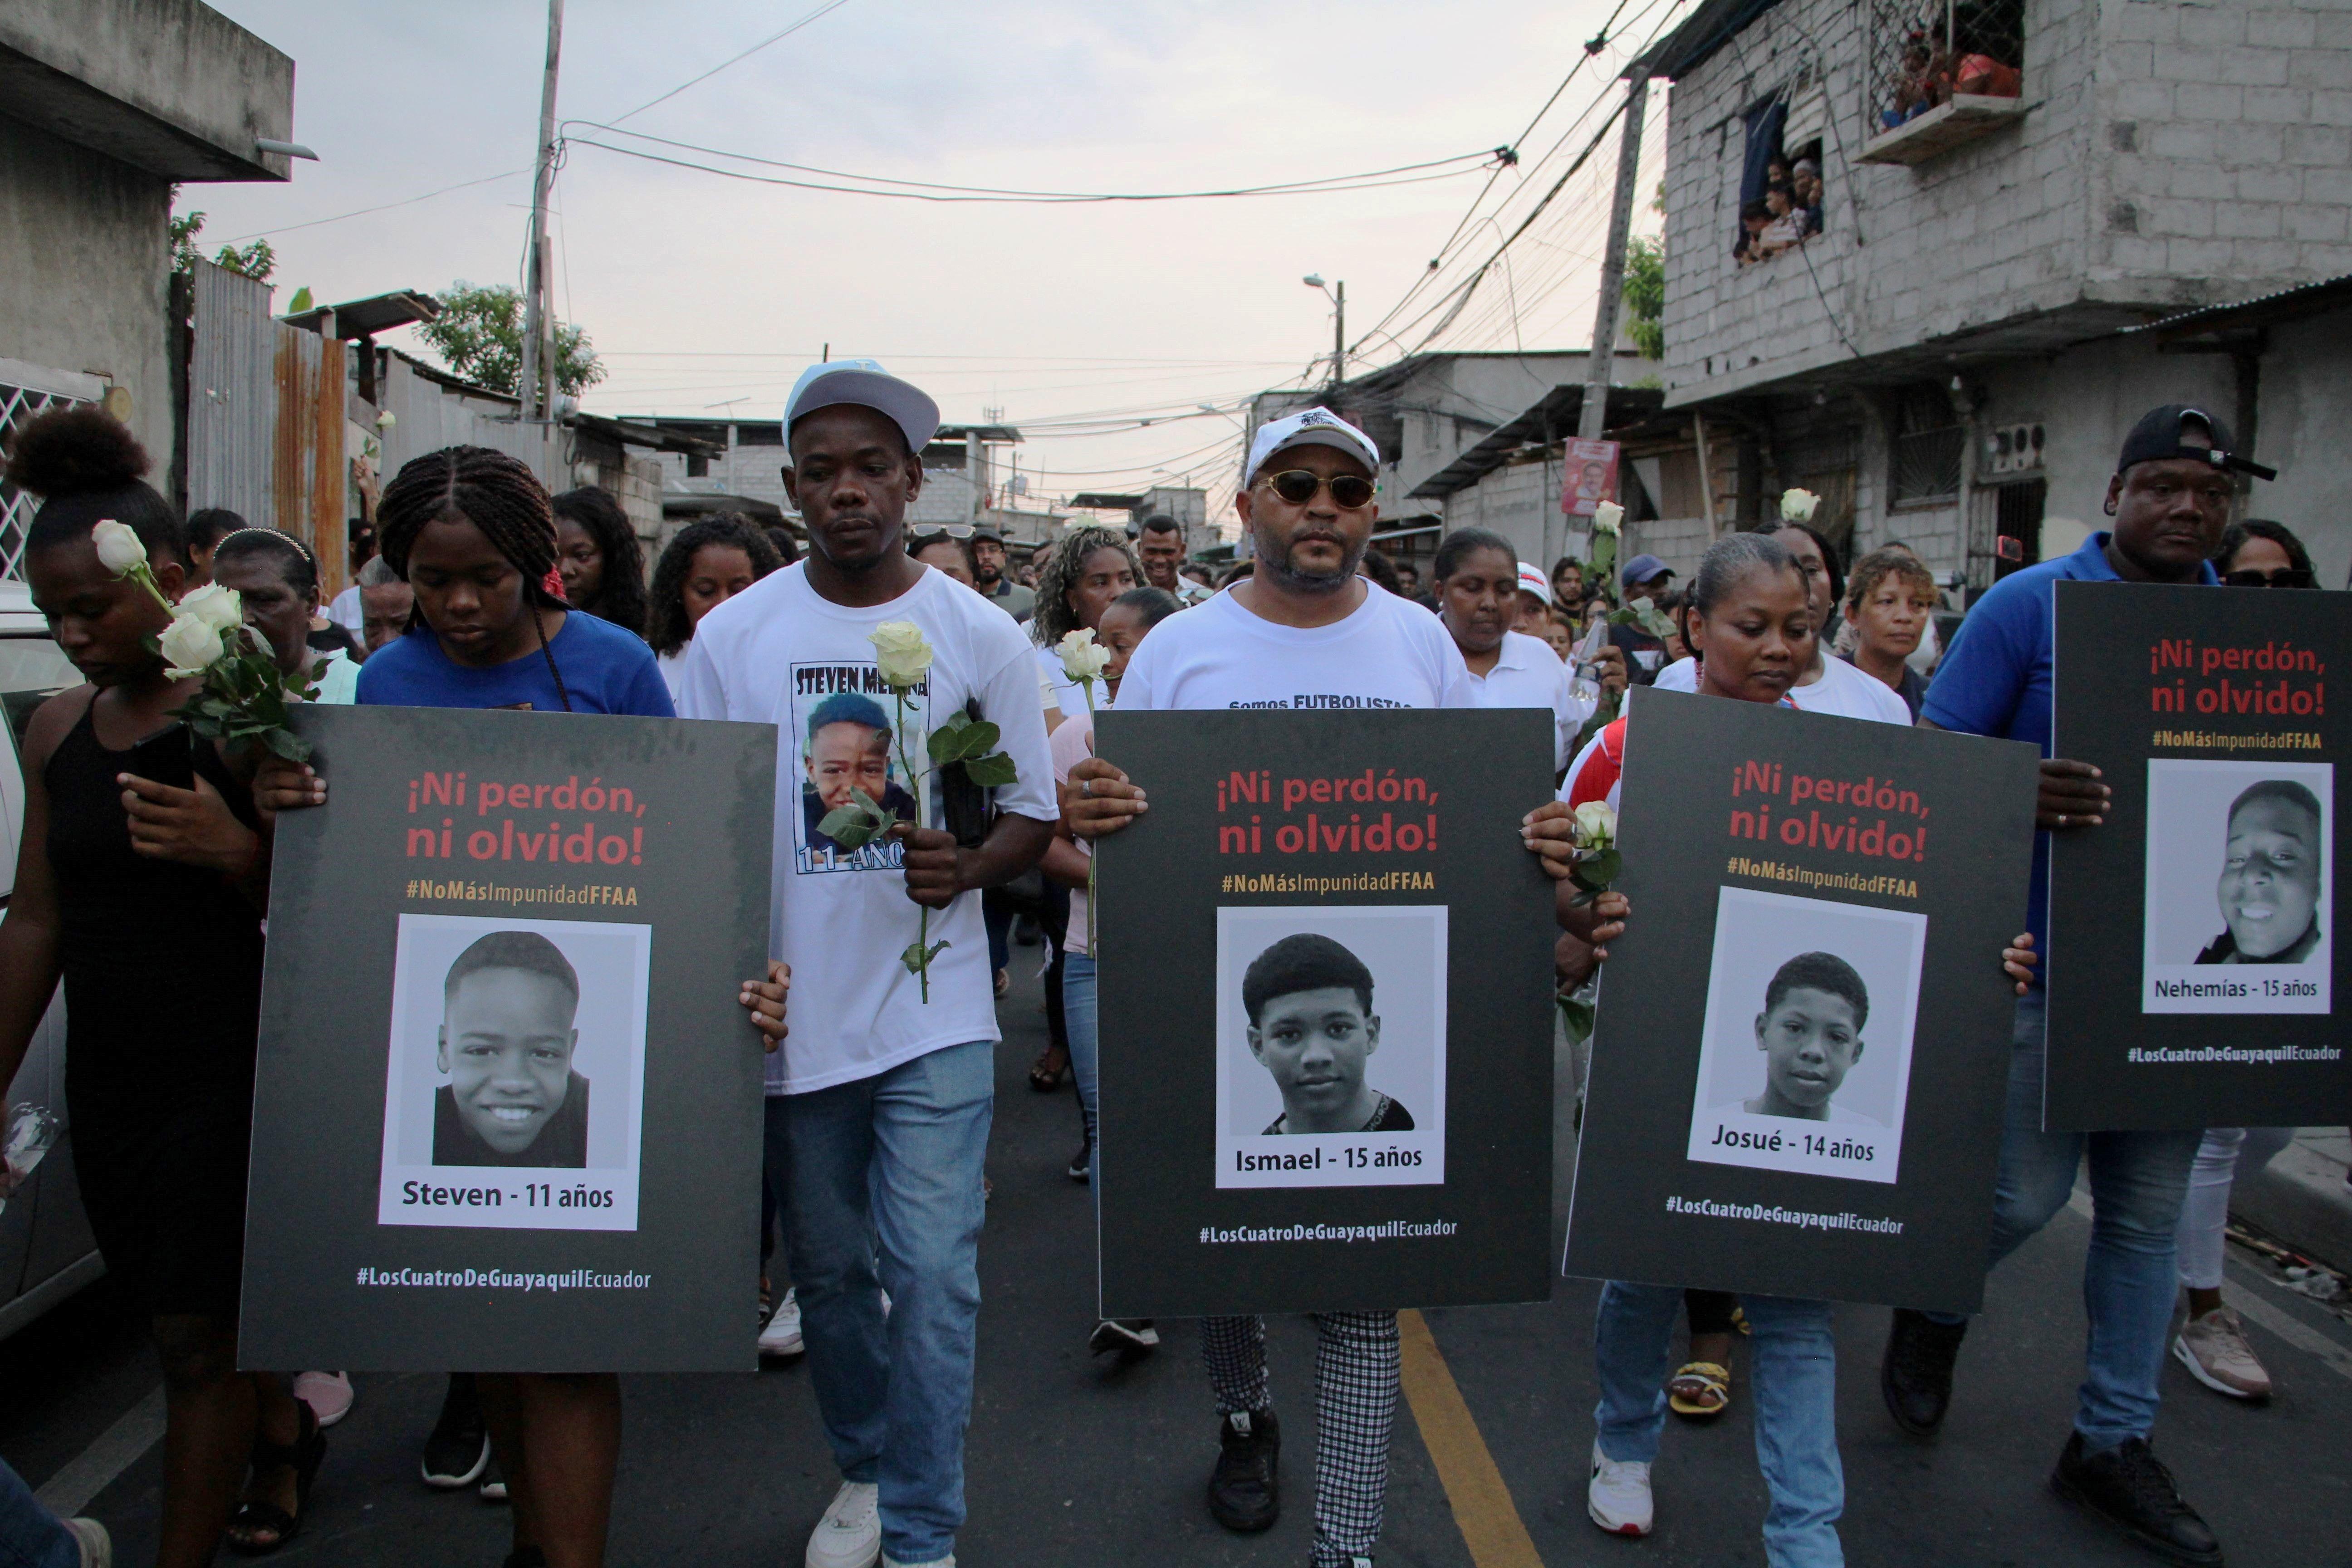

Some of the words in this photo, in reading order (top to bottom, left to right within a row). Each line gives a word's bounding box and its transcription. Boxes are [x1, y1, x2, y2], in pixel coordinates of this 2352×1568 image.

[2151, 639, 2192, 674] ¡Ni
[2202, 641, 2325, 676] perdón,
[796, 666, 859, 695] STEVEN
[2152, 678, 2185, 712] ni
[2196, 679, 2324, 715] olvido!
[2153, 730, 2322, 750] #NoMásImpunidadFFAA
[409, 772, 466, 813] ¡Ni
[478, 776, 646, 818] perdón,
[1217, 770, 1270, 812] ¡Ni
[1283, 769, 1439, 811] perdón,
[1733, 760, 1782, 796] ¡Ni
[1790, 775, 1930, 819] perdón,
[407, 818, 452, 858] ni
[468, 819, 643, 865] olvido!
[1220, 815, 1261, 853] ni
[1275, 813, 1437, 853] olvido!
[1730, 804, 1769, 840] ni
[1779, 810, 1926, 862] olvido!
[407, 879, 638, 906] #NoMásImpunidadFFAA
[1222, 871, 1436, 896] #NoMásImpunidadFFAA
[1727, 857, 1918, 898] #NoMásImpunidadFFAA
[2155, 979, 2247, 998] Nehemías
[2263, 980, 2279, 997] 15
[2283, 979, 2318, 997] años
[2127, 1044, 2342, 1064] #LosCuatroDeGuayaquilEcuador
[1236, 1147, 1321, 1172] Ismael
[1344, 1147, 1368, 1169] 15
[1373, 1145, 1422, 1168] años
[1711, 1124, 1782, 1152] Josué
[1804, 1134, 1826, 1156] 14
[1829, 1137, 1874, 1161] años
[402, 1180, 502, 1206] Steven
[525, 1183, 550, 1207] 11
[558, 1183, 613, 1208] años
[1199, 1218, 1458, 1243] #LosCuatroDeGuayaquilEcuador
[1666, 1195, 1904, 1235] #LosCuatroDeGuayaquilEcuador
[356, 1267, 652, 1292] #LosCuatroDeGuayaquilEcuador
